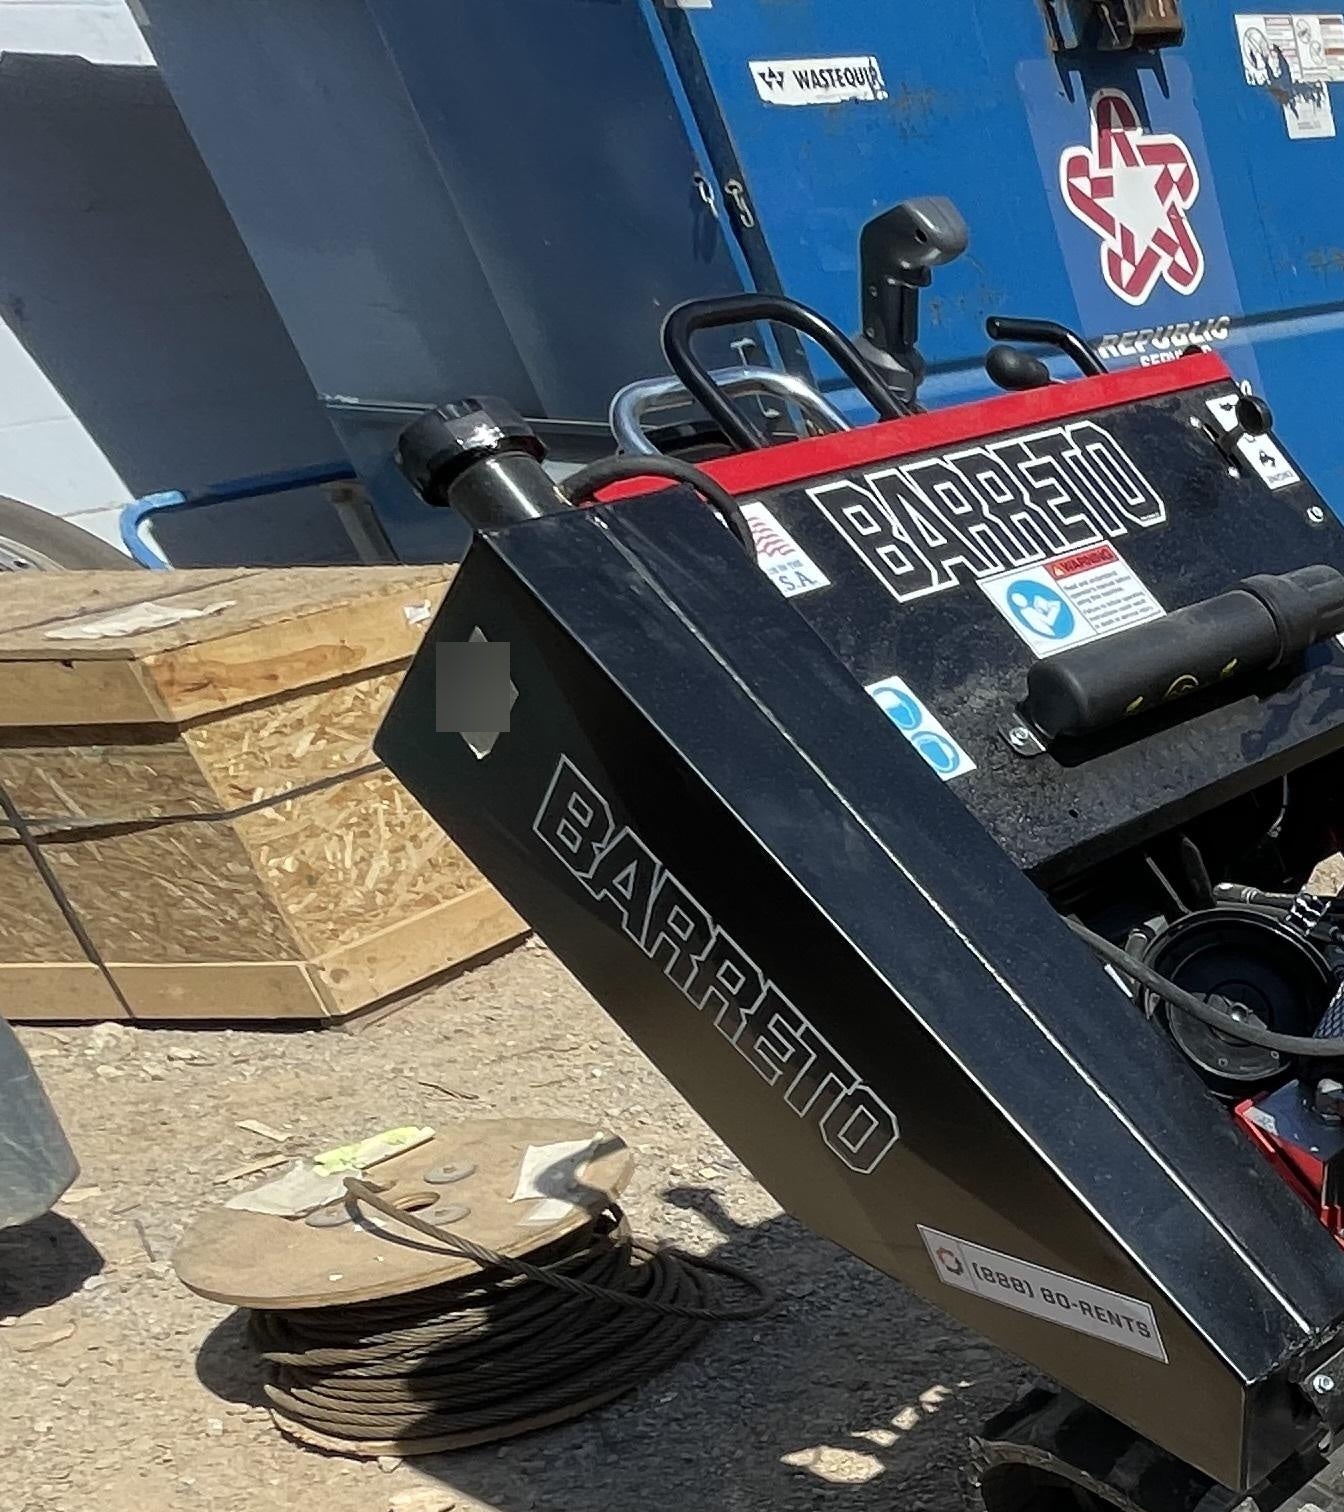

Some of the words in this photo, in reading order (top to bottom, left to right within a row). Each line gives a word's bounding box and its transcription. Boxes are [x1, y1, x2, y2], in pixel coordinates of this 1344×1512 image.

[1097, 316, 1231, 359] REPUBLIC
[805, 420, 1167, 603] BARRETO
[1061, 548, 1114, 574] WARNING
[533, 754, 900, 1174] BARRETO
[972, 1262, 1034, 1298] (888)
[1040, 1286, 1151, 1338] 80-RENTS
